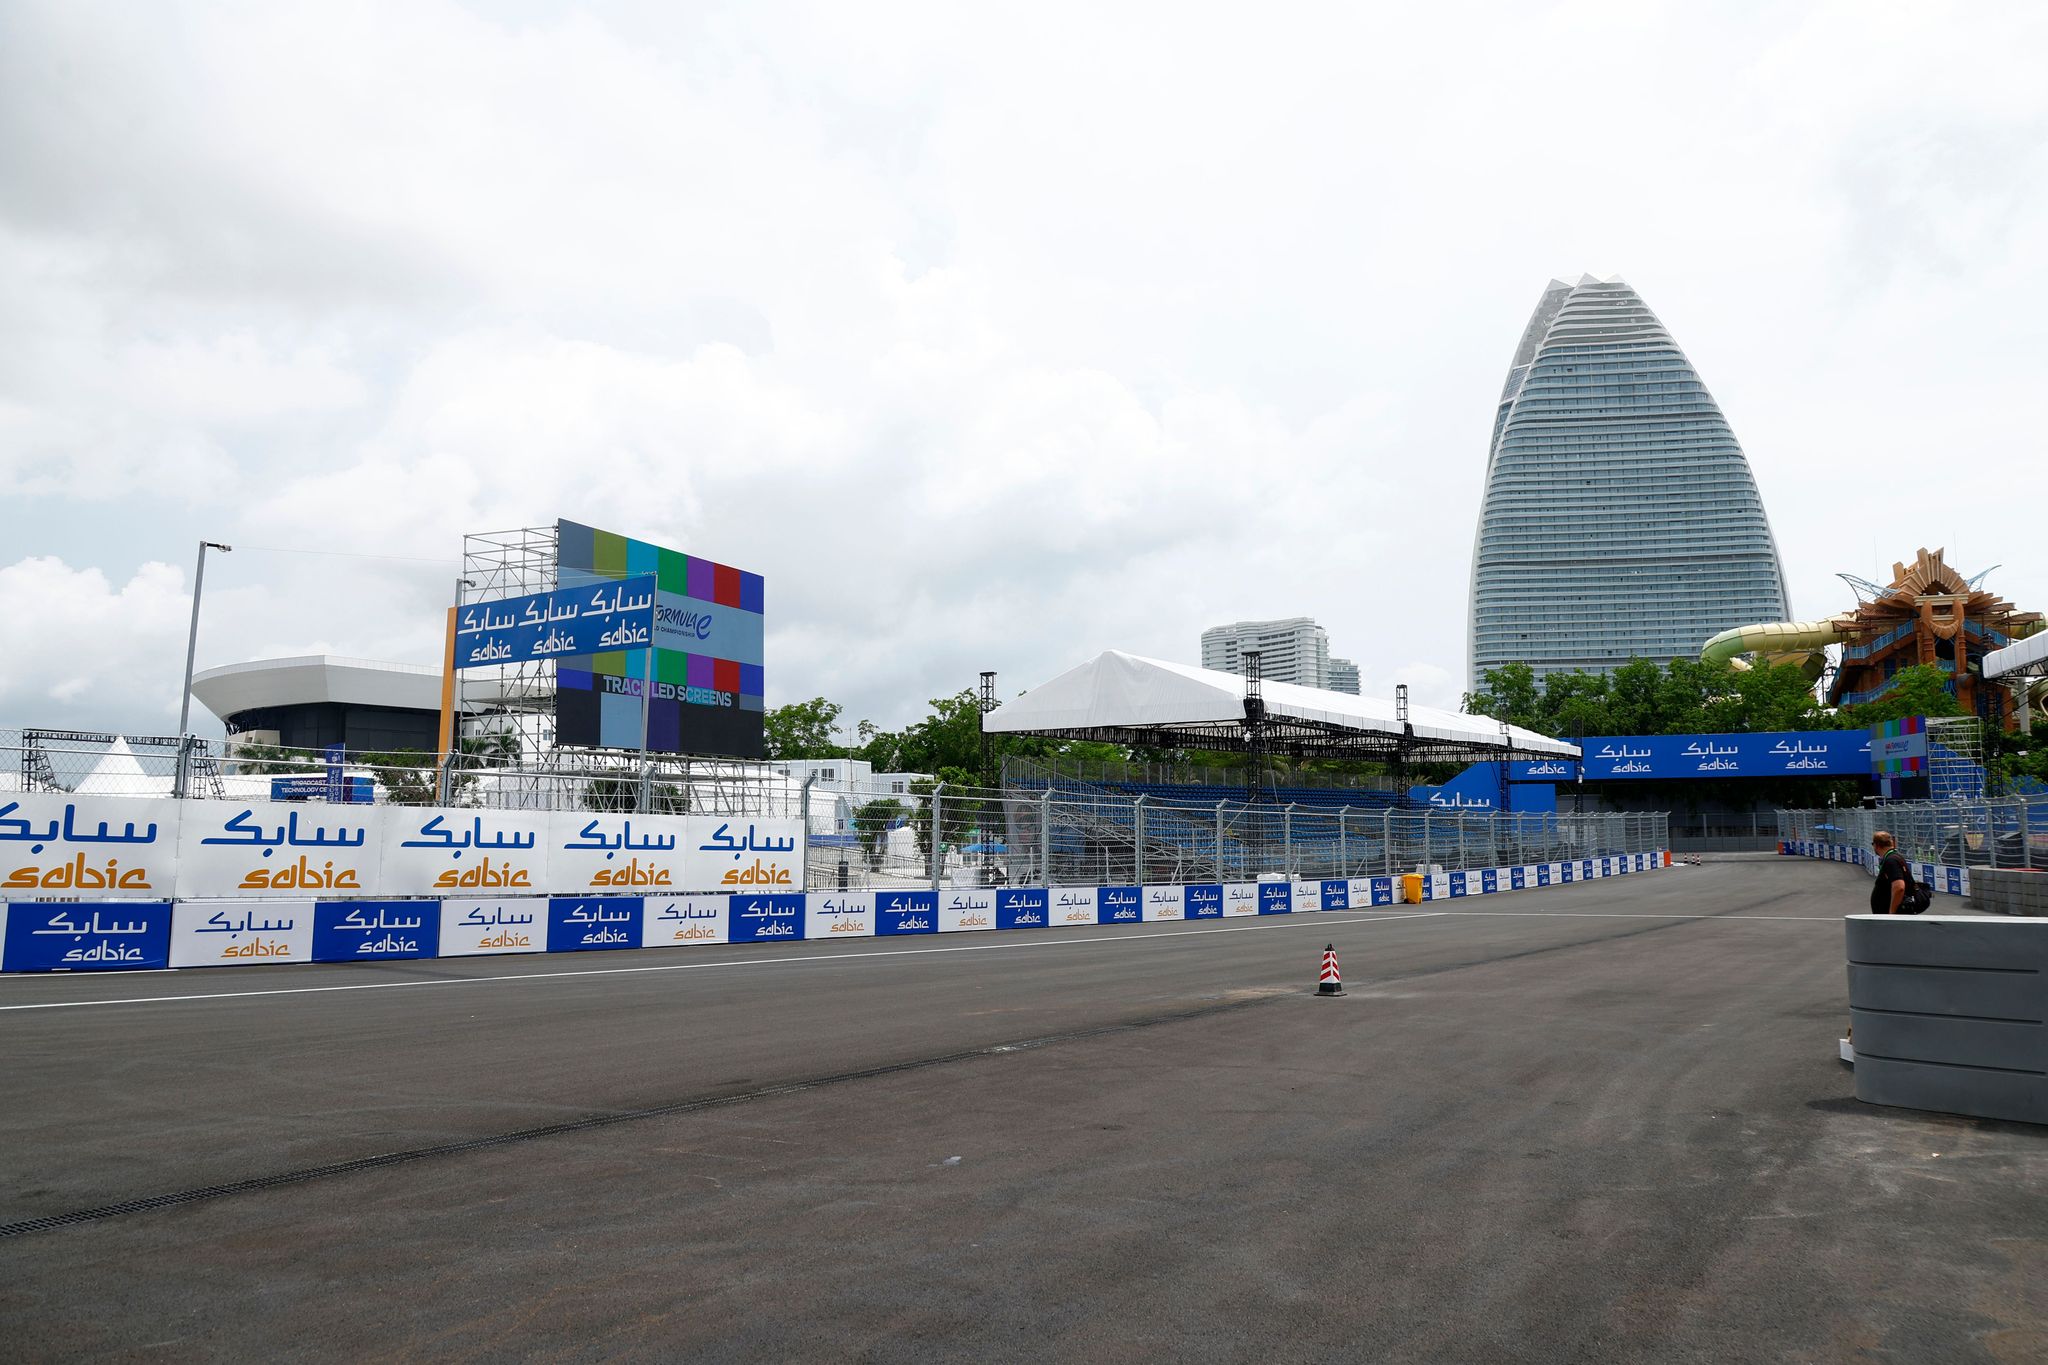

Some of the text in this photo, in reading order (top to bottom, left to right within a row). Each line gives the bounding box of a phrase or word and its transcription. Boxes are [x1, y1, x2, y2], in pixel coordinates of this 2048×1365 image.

[582, 586, 652, 623] سابك
[458, 607, 514, 638] سابك
[518, 599, 578, 632] سابك
[531, 628, 576, 655] sabic
[598, 619, 648, 648] sabic
[661, 627, 695, 638] CHAMPIONSHIP
[469, 640, 512, 662] sabic
[652, 682, 676, 699] LED
[678, 685, 732, 706] SCREENS
[1595, 744, 1652, 762] سابك
[1681, 741, 1739, 758] سابك
[1769, 740, 1828, 758] سابك
[1526, 762, 1567, 775] sabic
[1611, 760, 1652, 773] sabic
[1697, 757, 1739, 771] sabic
[1785, 757, 1828, 770] sabic
[200, 808, 366, 858] سابك
[401, 815, 536, 860] سابك
[564, 819, 676, 860] سابك
[698, 822, 795, 861] سابك
[0, 851, 153, 890] sabic
[237, 854, 362, 890] sabic
[432, 856, 533, 888] sabic
[588, 858, 673, 887] sabic
[720, 858, 793, 886] sabic
[816, 899, 866, 919] سابك
[885, 898, 930, 918] سابك
[948, 896, 988, 914] سابك
[1004, 895, 1042, 912] سابك
[1056, 894, 1091, 909] سابك
[1104, 892, 1137, 908] سابك
[1198, 904, 1218, 916] sabic
[458, 906, 533, 932] سابك
[562, 904, 631, 928] سابك
[656, 903, 718, 924] سابك
[740, 901, 796, 922] سابك
[958, 912, 988, 926] sabic
[1014, 910, 1042, 924] sabic
[1066, 908, 1091, 921] sabic
[1113, 907, 1136, 919] sabic
[1157, 905, 1178, 917] sabic
[32, 911, 148, 942] سابك
[194, 911, 294, 939] سابك
[333, 908, 422, 935] سابك
[672, 923, 716, 940] sabic
[756, 920, 794, 936] sabic
[830, 918, 865, 932] sabic
[896, 914, 930, 930] sabic
[356, 933, 418, 953] sabic
[478, 930, 531, 948] sabic
[580, 926, 629, 944] sabic
[61, 940, 144, 961] sabic
[220, 937, 291, 958] sabic
